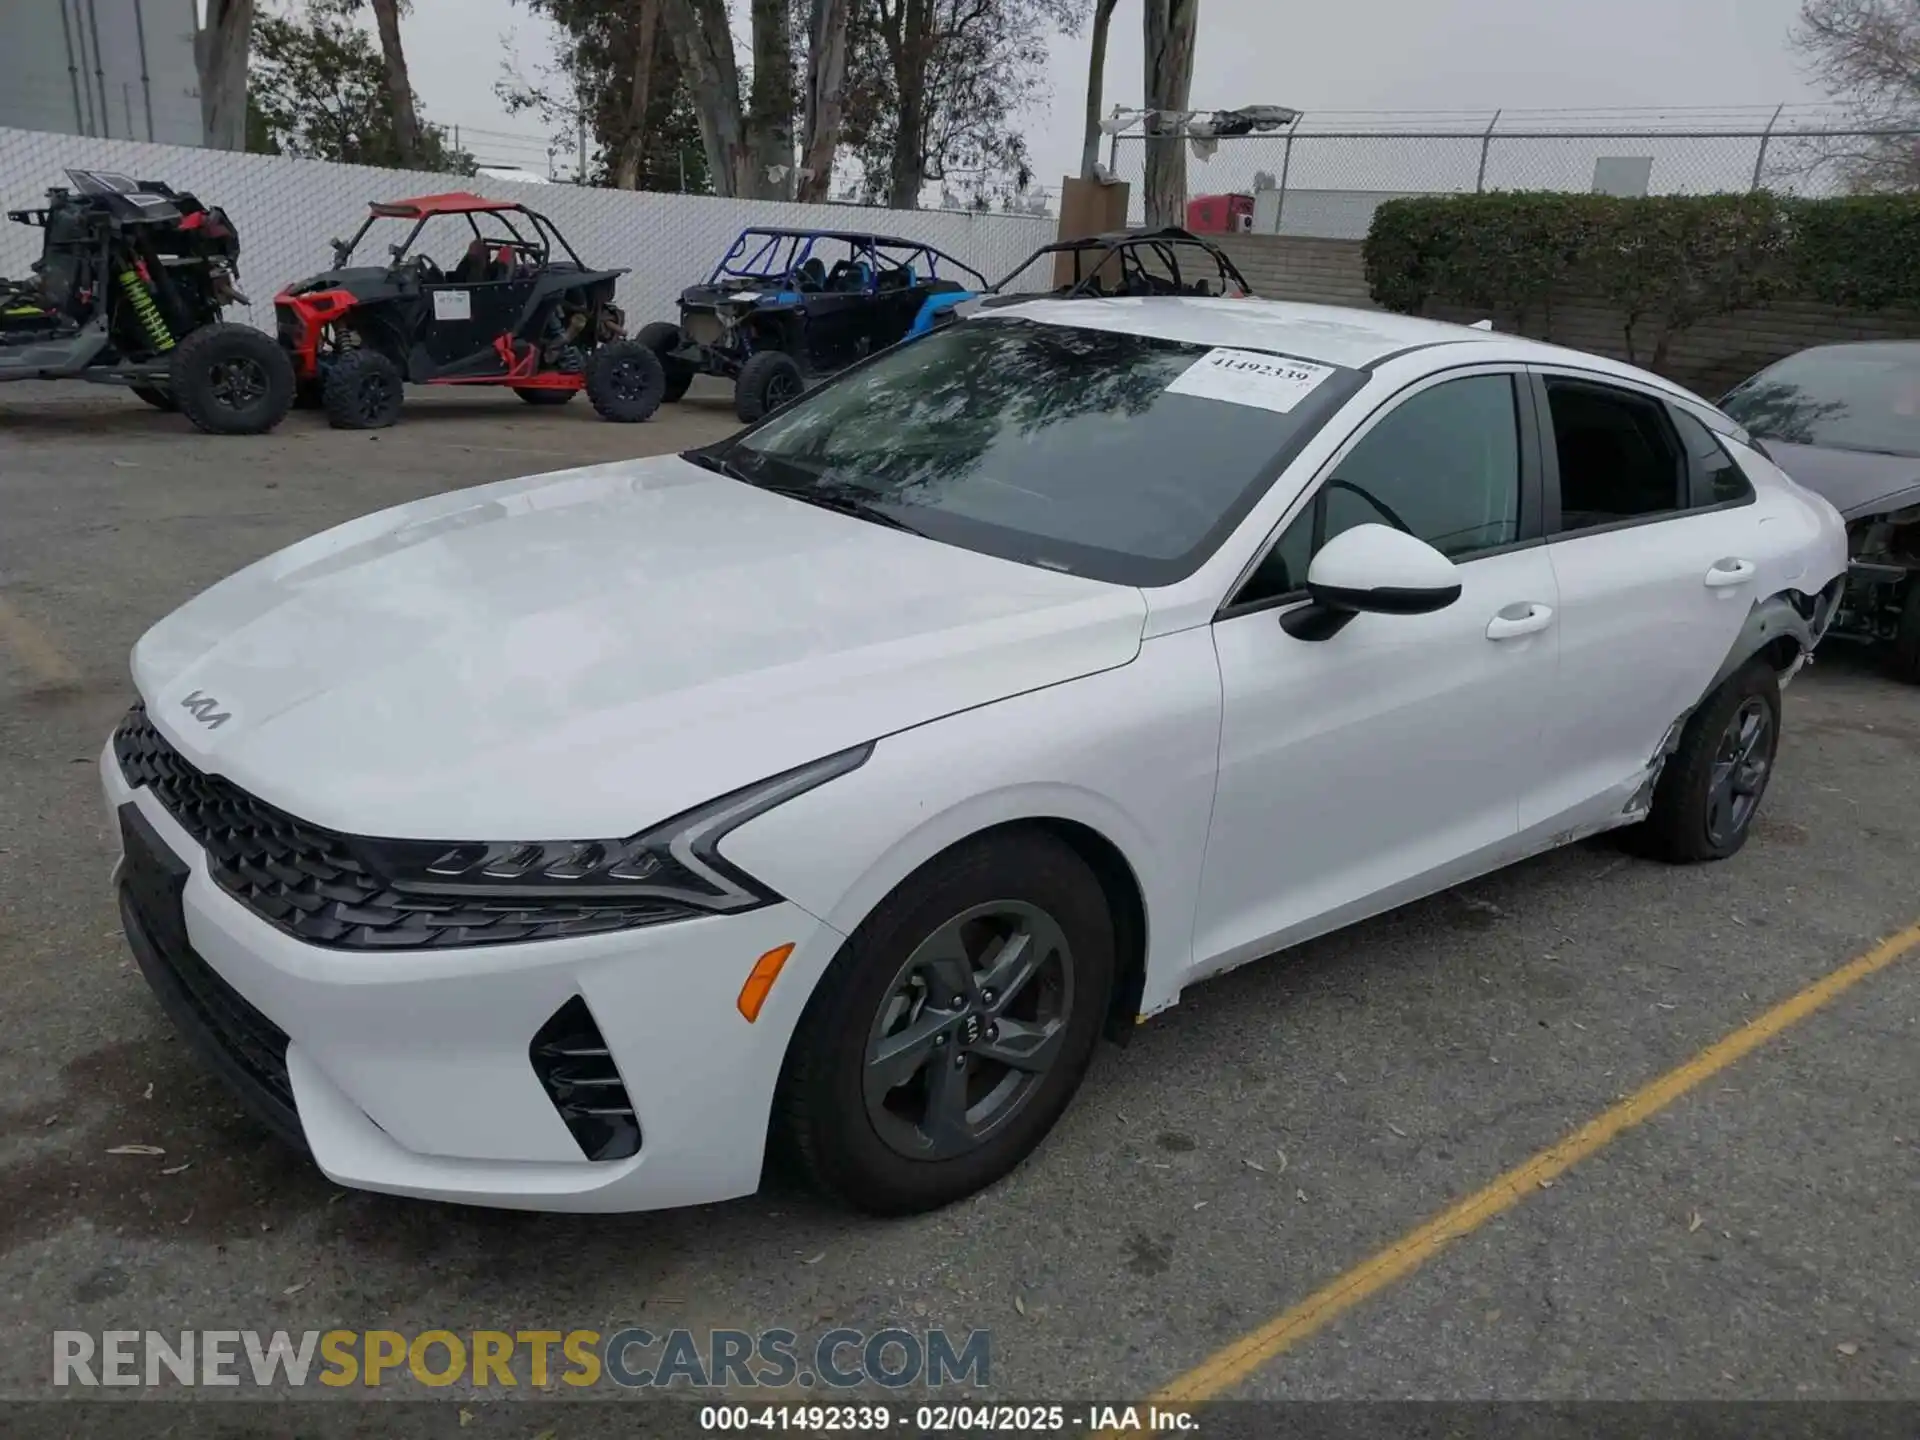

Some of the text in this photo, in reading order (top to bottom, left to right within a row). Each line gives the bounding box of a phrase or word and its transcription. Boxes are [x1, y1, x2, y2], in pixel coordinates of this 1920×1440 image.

[1211, 357, 1310, 381] 41492339
[180, 690, 232, 730] KIA
[967, 1015, 979, 1044] KIA
